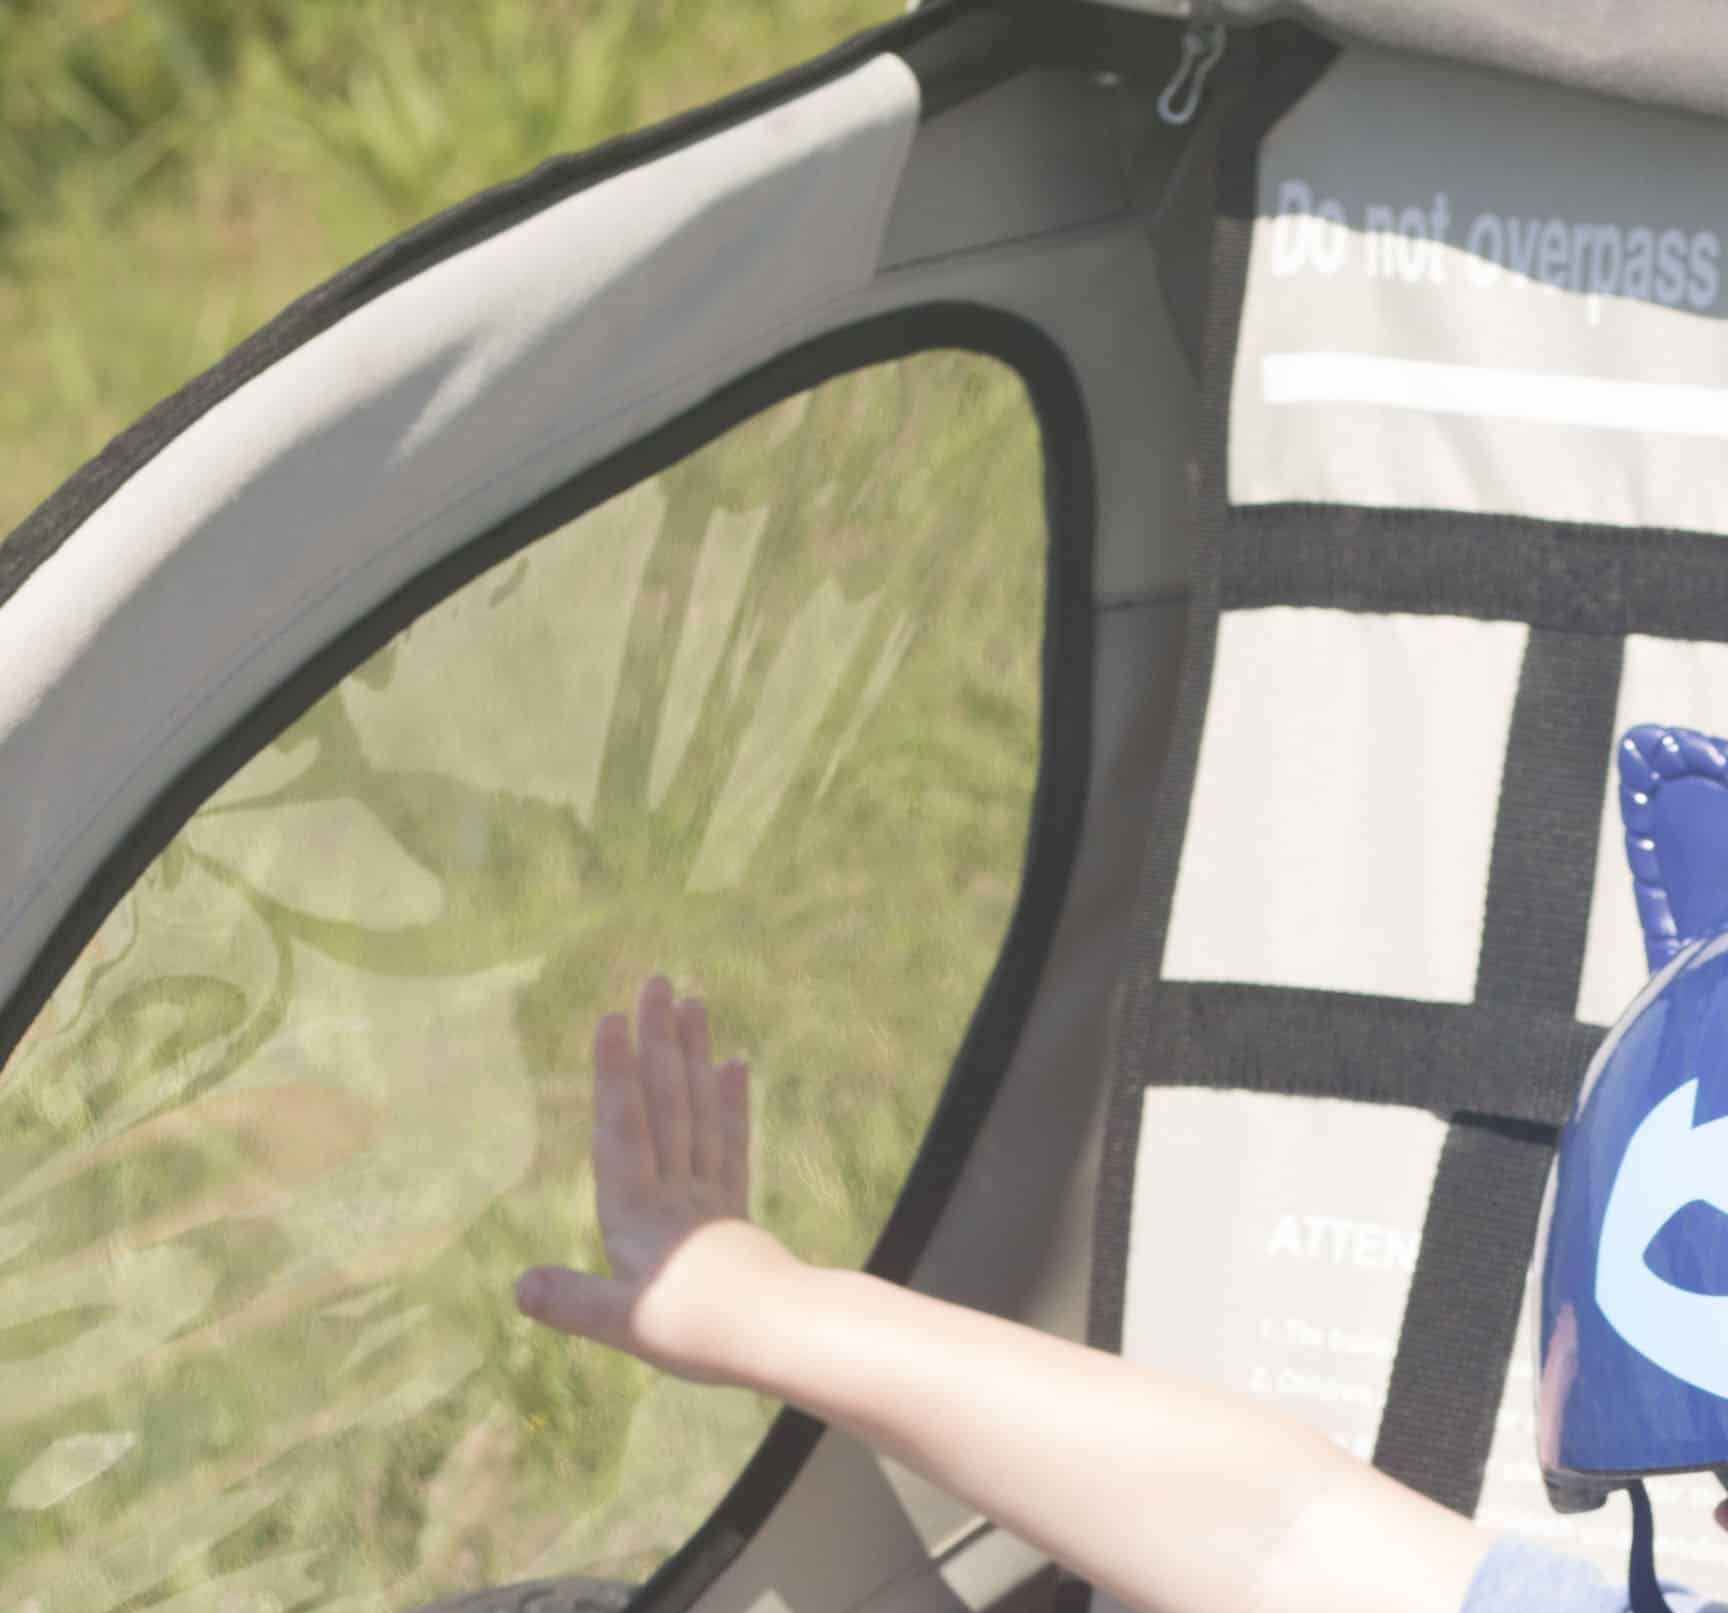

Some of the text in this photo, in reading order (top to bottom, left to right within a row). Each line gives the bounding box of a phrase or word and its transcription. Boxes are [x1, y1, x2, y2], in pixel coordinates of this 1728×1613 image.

[1272, 180, 1346, 277] Do
[1366, 191, 1451, 284] not
[1468, 212, 1721, 326] overpass
